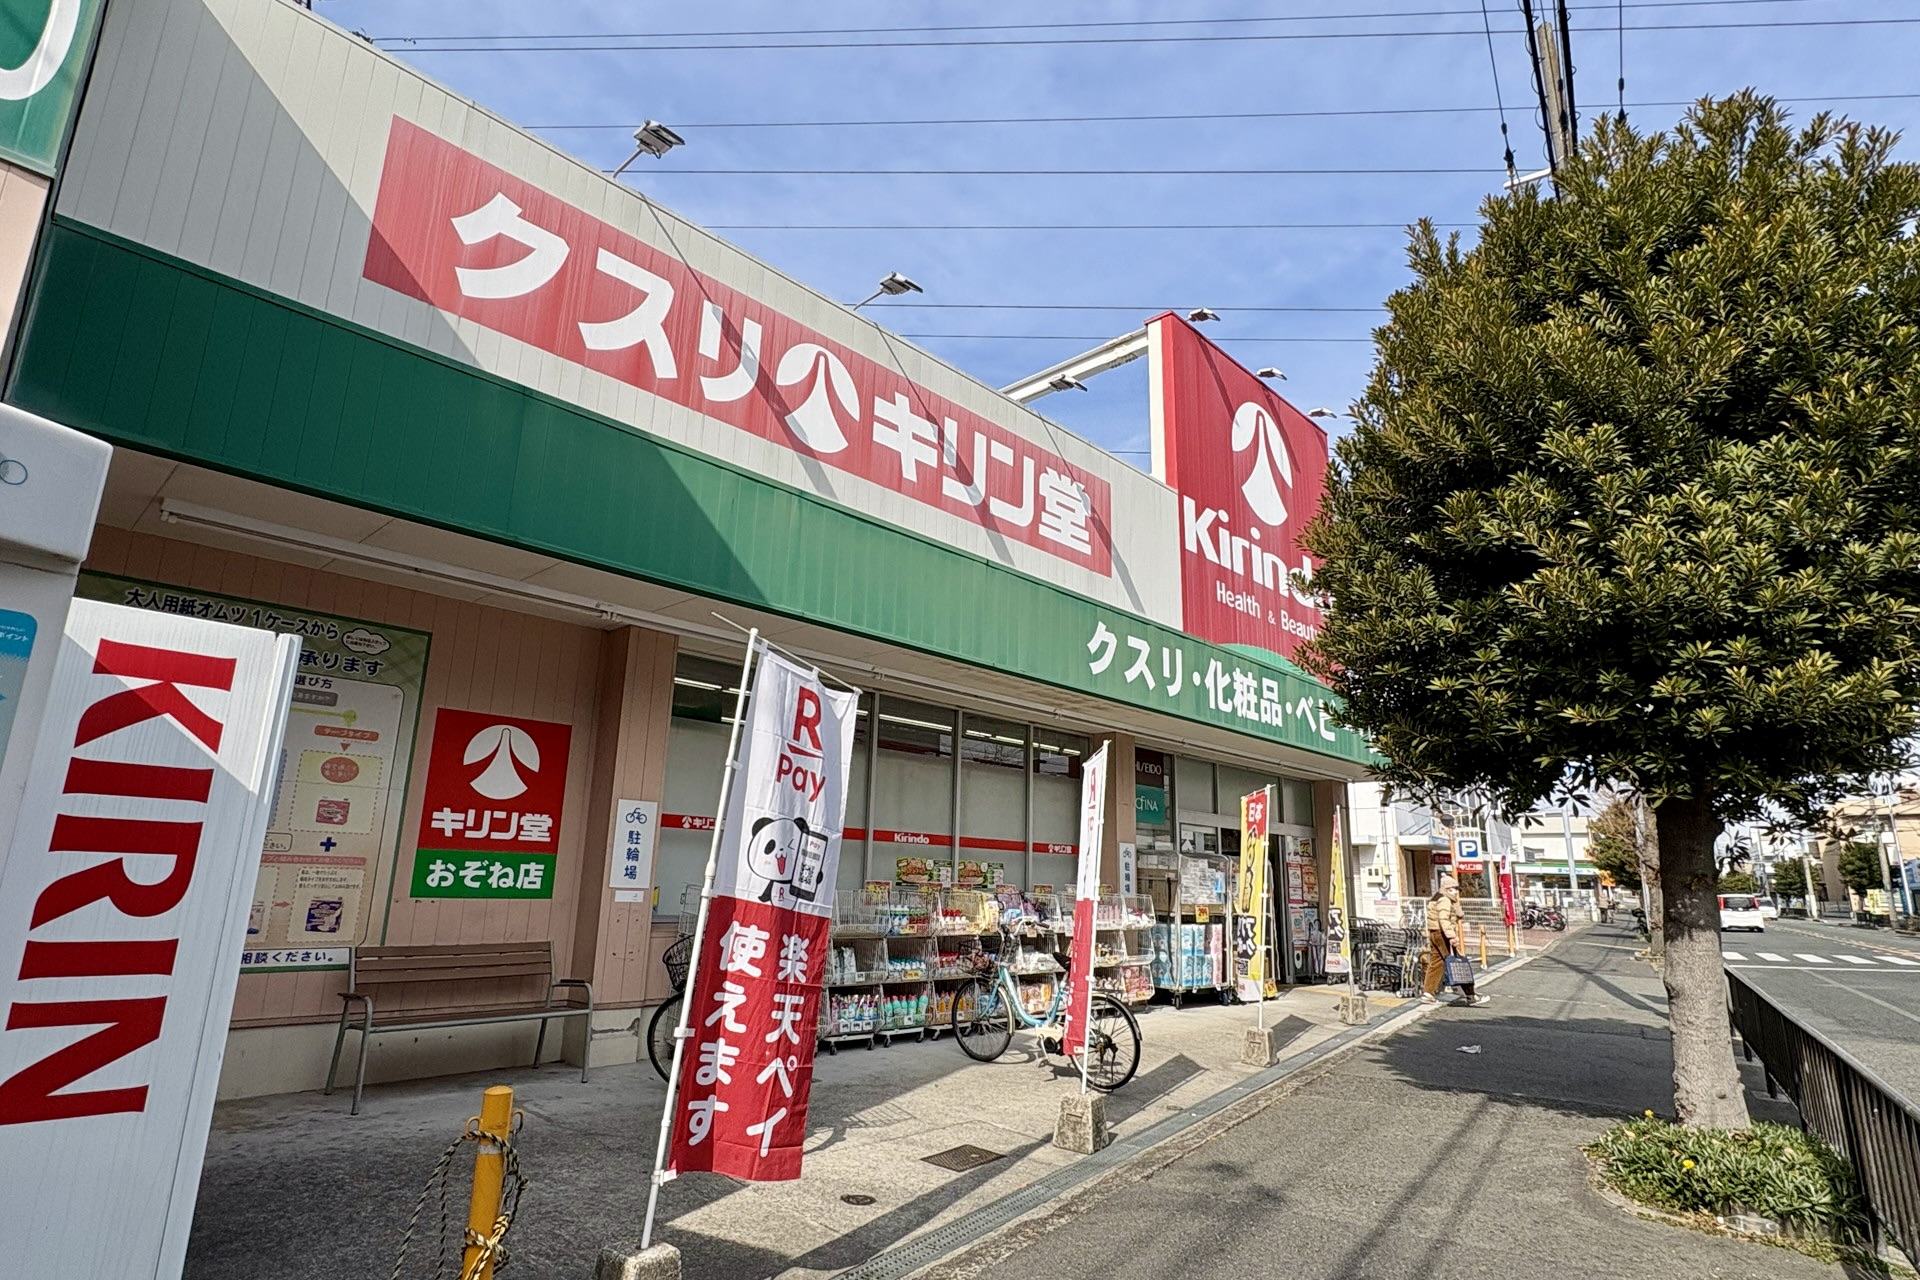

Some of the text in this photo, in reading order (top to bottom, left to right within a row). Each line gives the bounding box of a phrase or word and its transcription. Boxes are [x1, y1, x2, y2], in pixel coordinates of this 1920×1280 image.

[451, 192, 1091, 557] クスリ キリン堂
[1216, 580, 1260, 619] Health
[1267, 609, 1276, 625] &
[1087, 621, 1381, 755] クスリ・化粧品・ベビ
[793, 686, 823, 750] R
[776, 753, 826, 802] Pay
[431, 807, 553, 842] キリン堂
[894, 833, 930, 844] Kirindo
[1461, 841, 1476, 856] P
[426, 859, 545, 890] おぞね店
[624, 830, 641, 880] 駐輪場
[0, 638, 237, 1126] KIRIN
[688, 920, 770, 1146] 使えます
[746, 934, 810, 1158] 楽天ペイ
